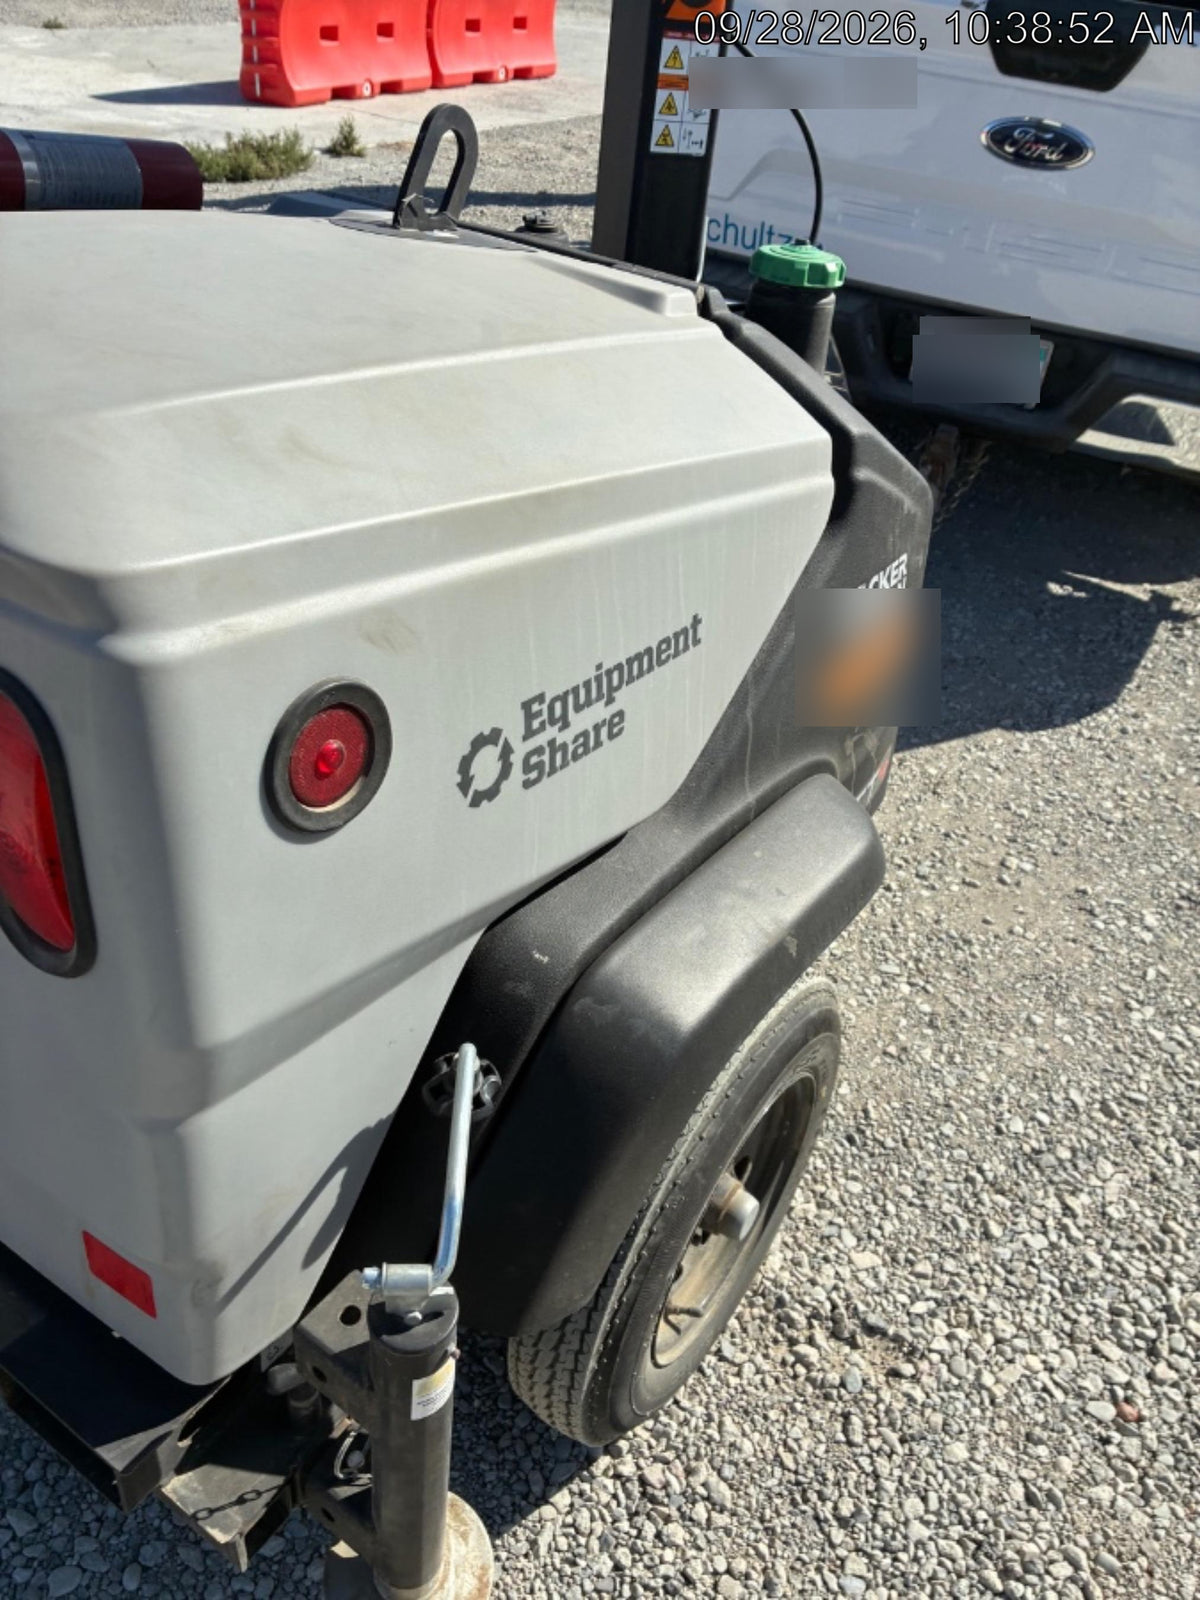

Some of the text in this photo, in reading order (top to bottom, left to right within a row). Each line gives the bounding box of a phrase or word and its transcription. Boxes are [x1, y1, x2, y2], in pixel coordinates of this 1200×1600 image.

[1004, 127, 1068, 161] Ford
[707, 213, 823, 250] chultz
[857, 552, 908, 589] CKER
[520, 613, 703, 742] Equipment
[521, 708, 626, 791] Share
